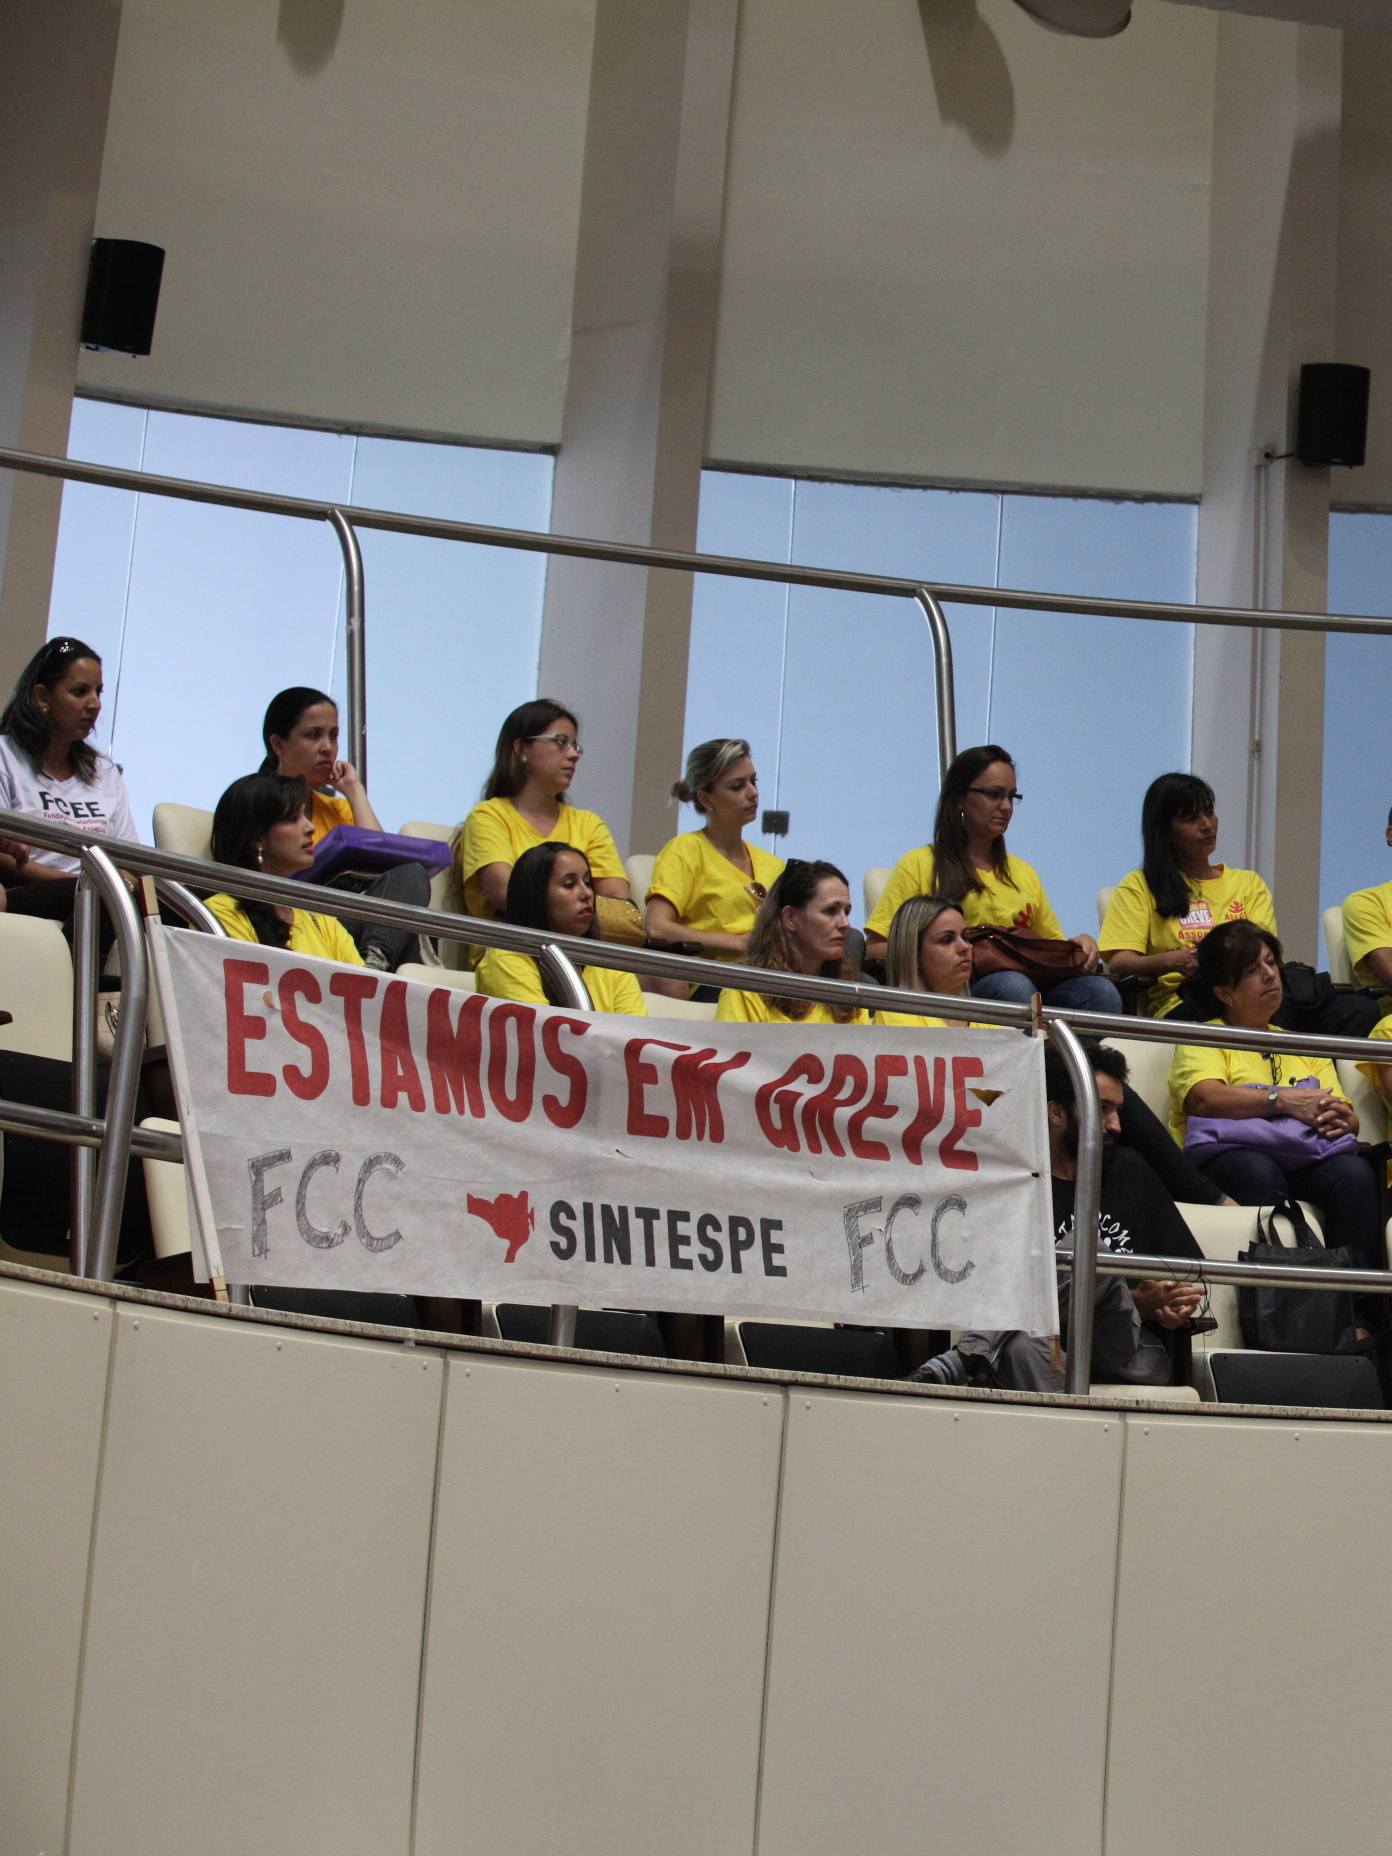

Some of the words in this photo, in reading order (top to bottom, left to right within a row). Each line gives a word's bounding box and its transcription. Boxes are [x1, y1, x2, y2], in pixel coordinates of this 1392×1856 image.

[39, 791, 106, 818] FCEE
[223, 958, 592, 1129] ESTAMOS
[624, 1038, 752, 1143] EM
[755, 1053, 985, 1171] GREVE
[248, 1147, 406, 1260] FCC
[549, 1200, 788, 1277] SINTESPE
[843, 1193, 977, 1294] FCC
